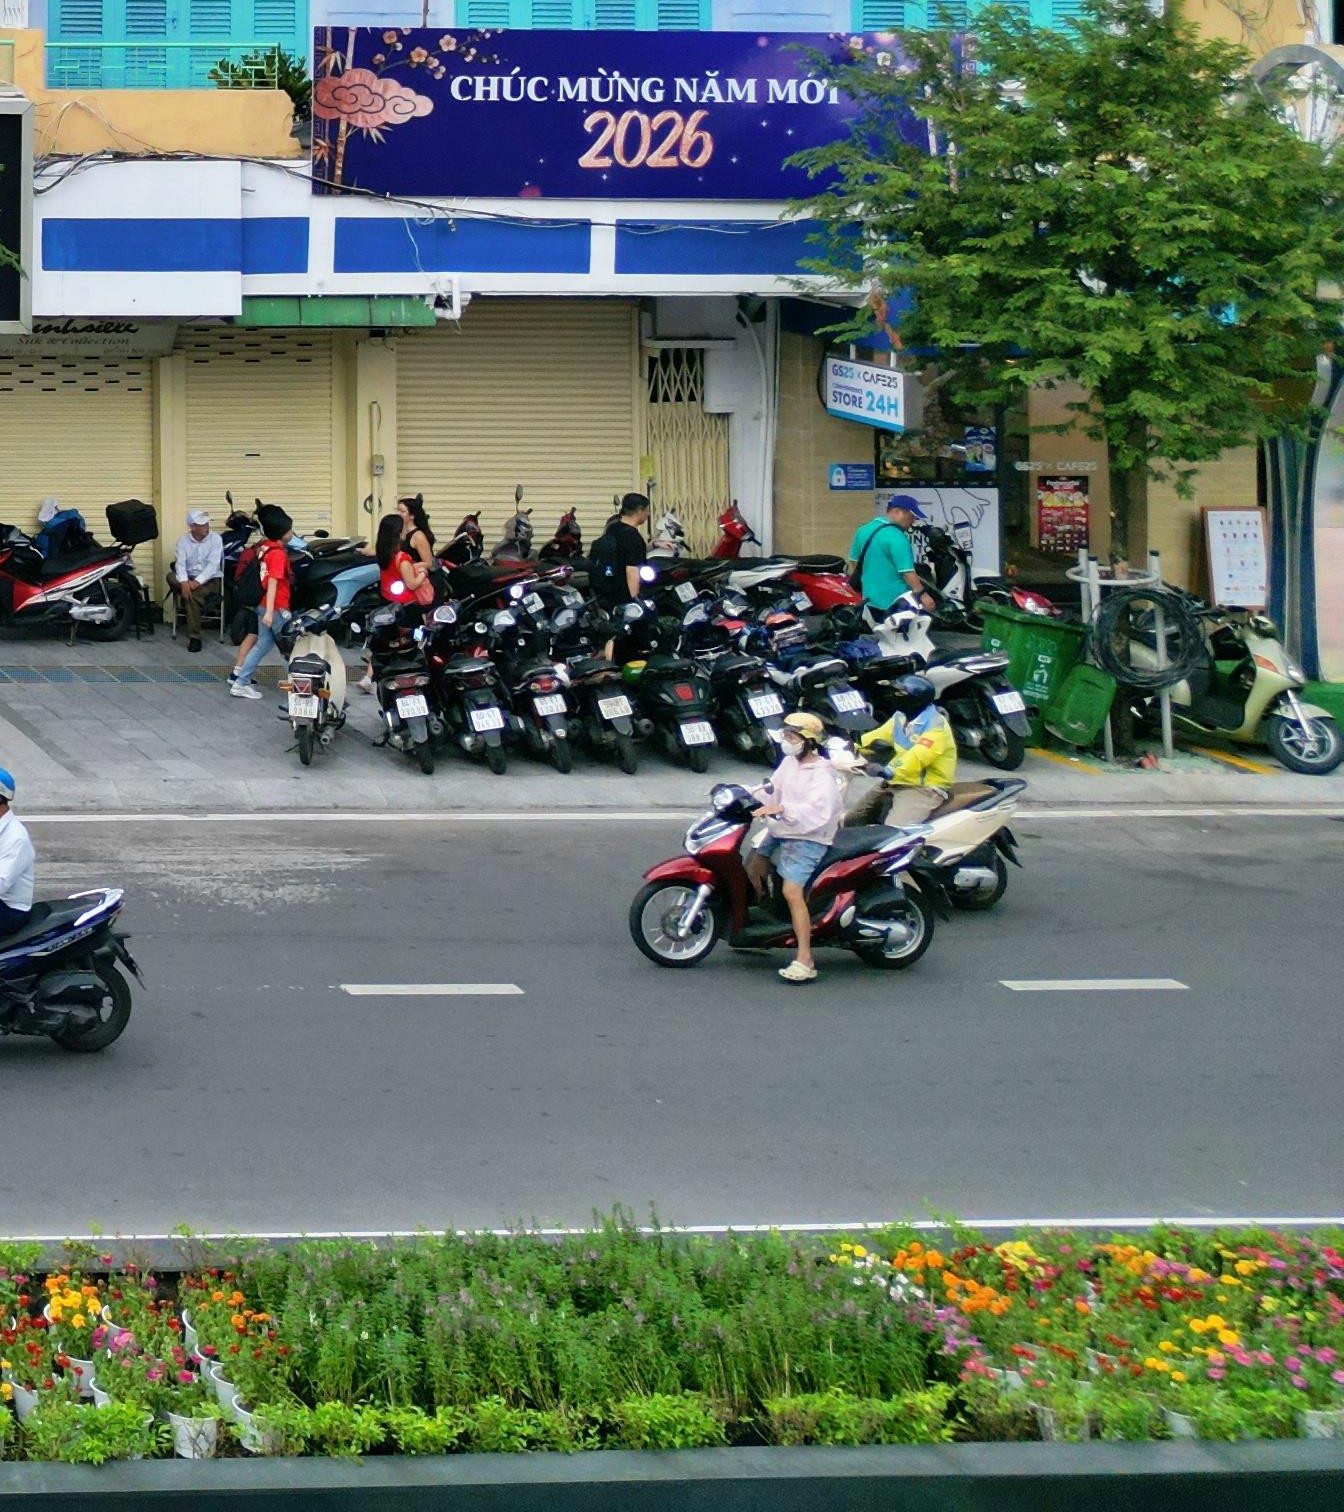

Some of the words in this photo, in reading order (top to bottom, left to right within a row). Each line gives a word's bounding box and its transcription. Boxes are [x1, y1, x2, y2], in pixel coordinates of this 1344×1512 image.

[450, 66, 549, 103] CHÚC
[557, 67, 667, 104] MỪNG
[674, 70, 758, 104] NĂM
[578, 109, 713, 169] 2026
[832, 364, 854, 379] GS25
[862, 370, 898, 389] CAFE25
[832, 390, 863, 409] STORE
[865, 390, 899, 418] 24H
